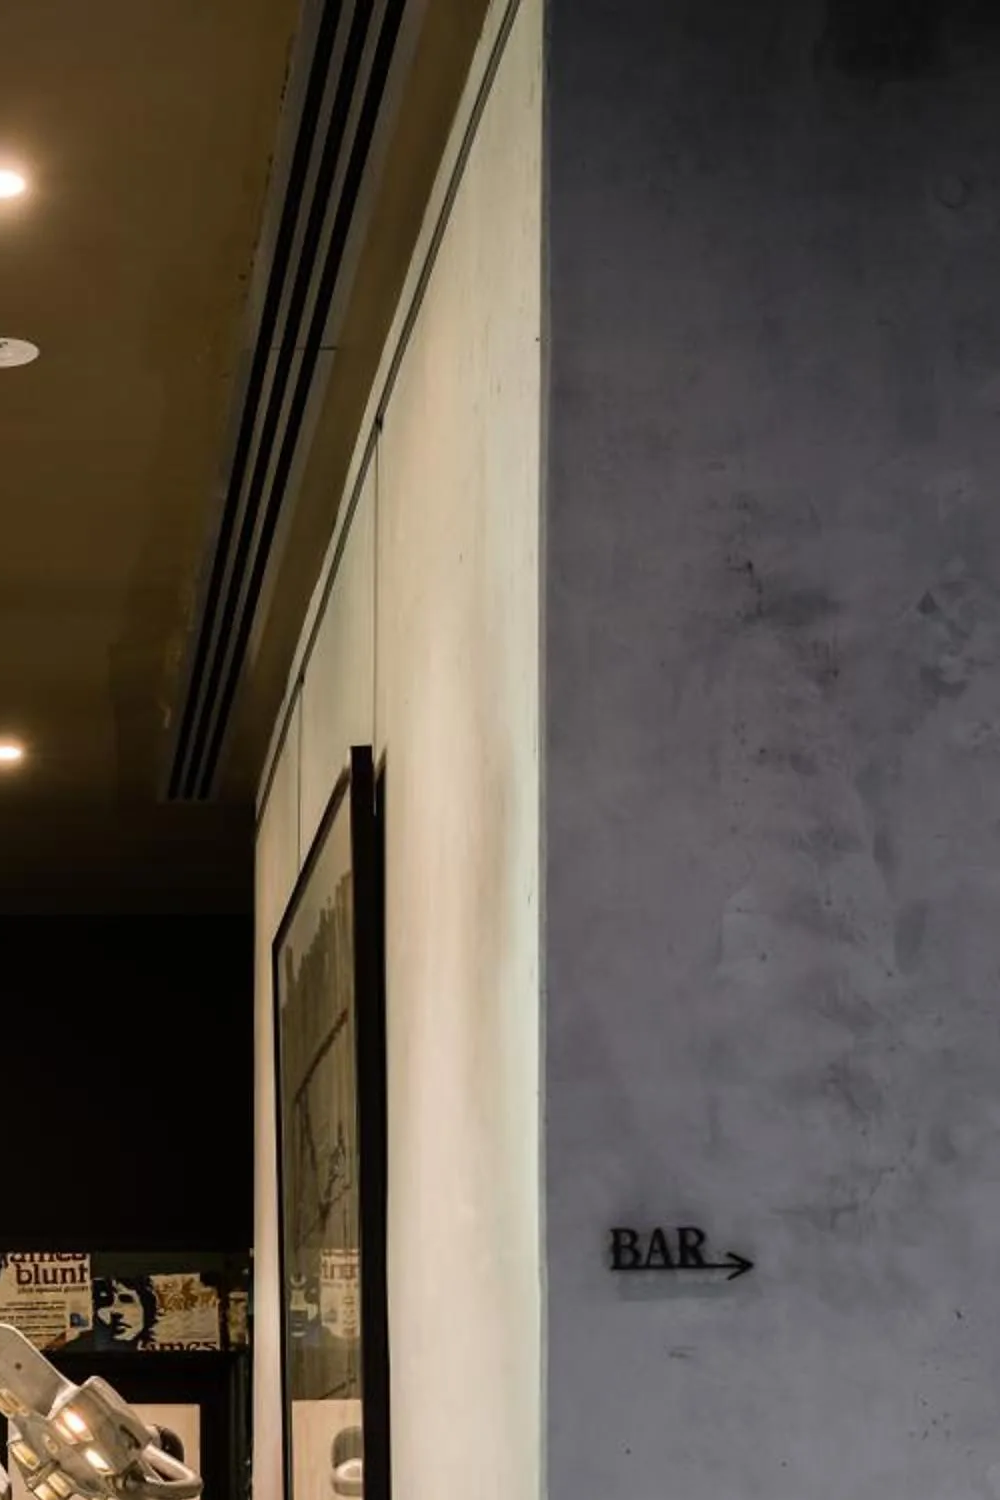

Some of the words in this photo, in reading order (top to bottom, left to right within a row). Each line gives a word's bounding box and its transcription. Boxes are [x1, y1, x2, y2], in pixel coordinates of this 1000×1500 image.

[609, 1227, 706, 1270] BAR
[1, 1253, 87, 1267] ames
[16, 1263, 88, 1285] blunt
